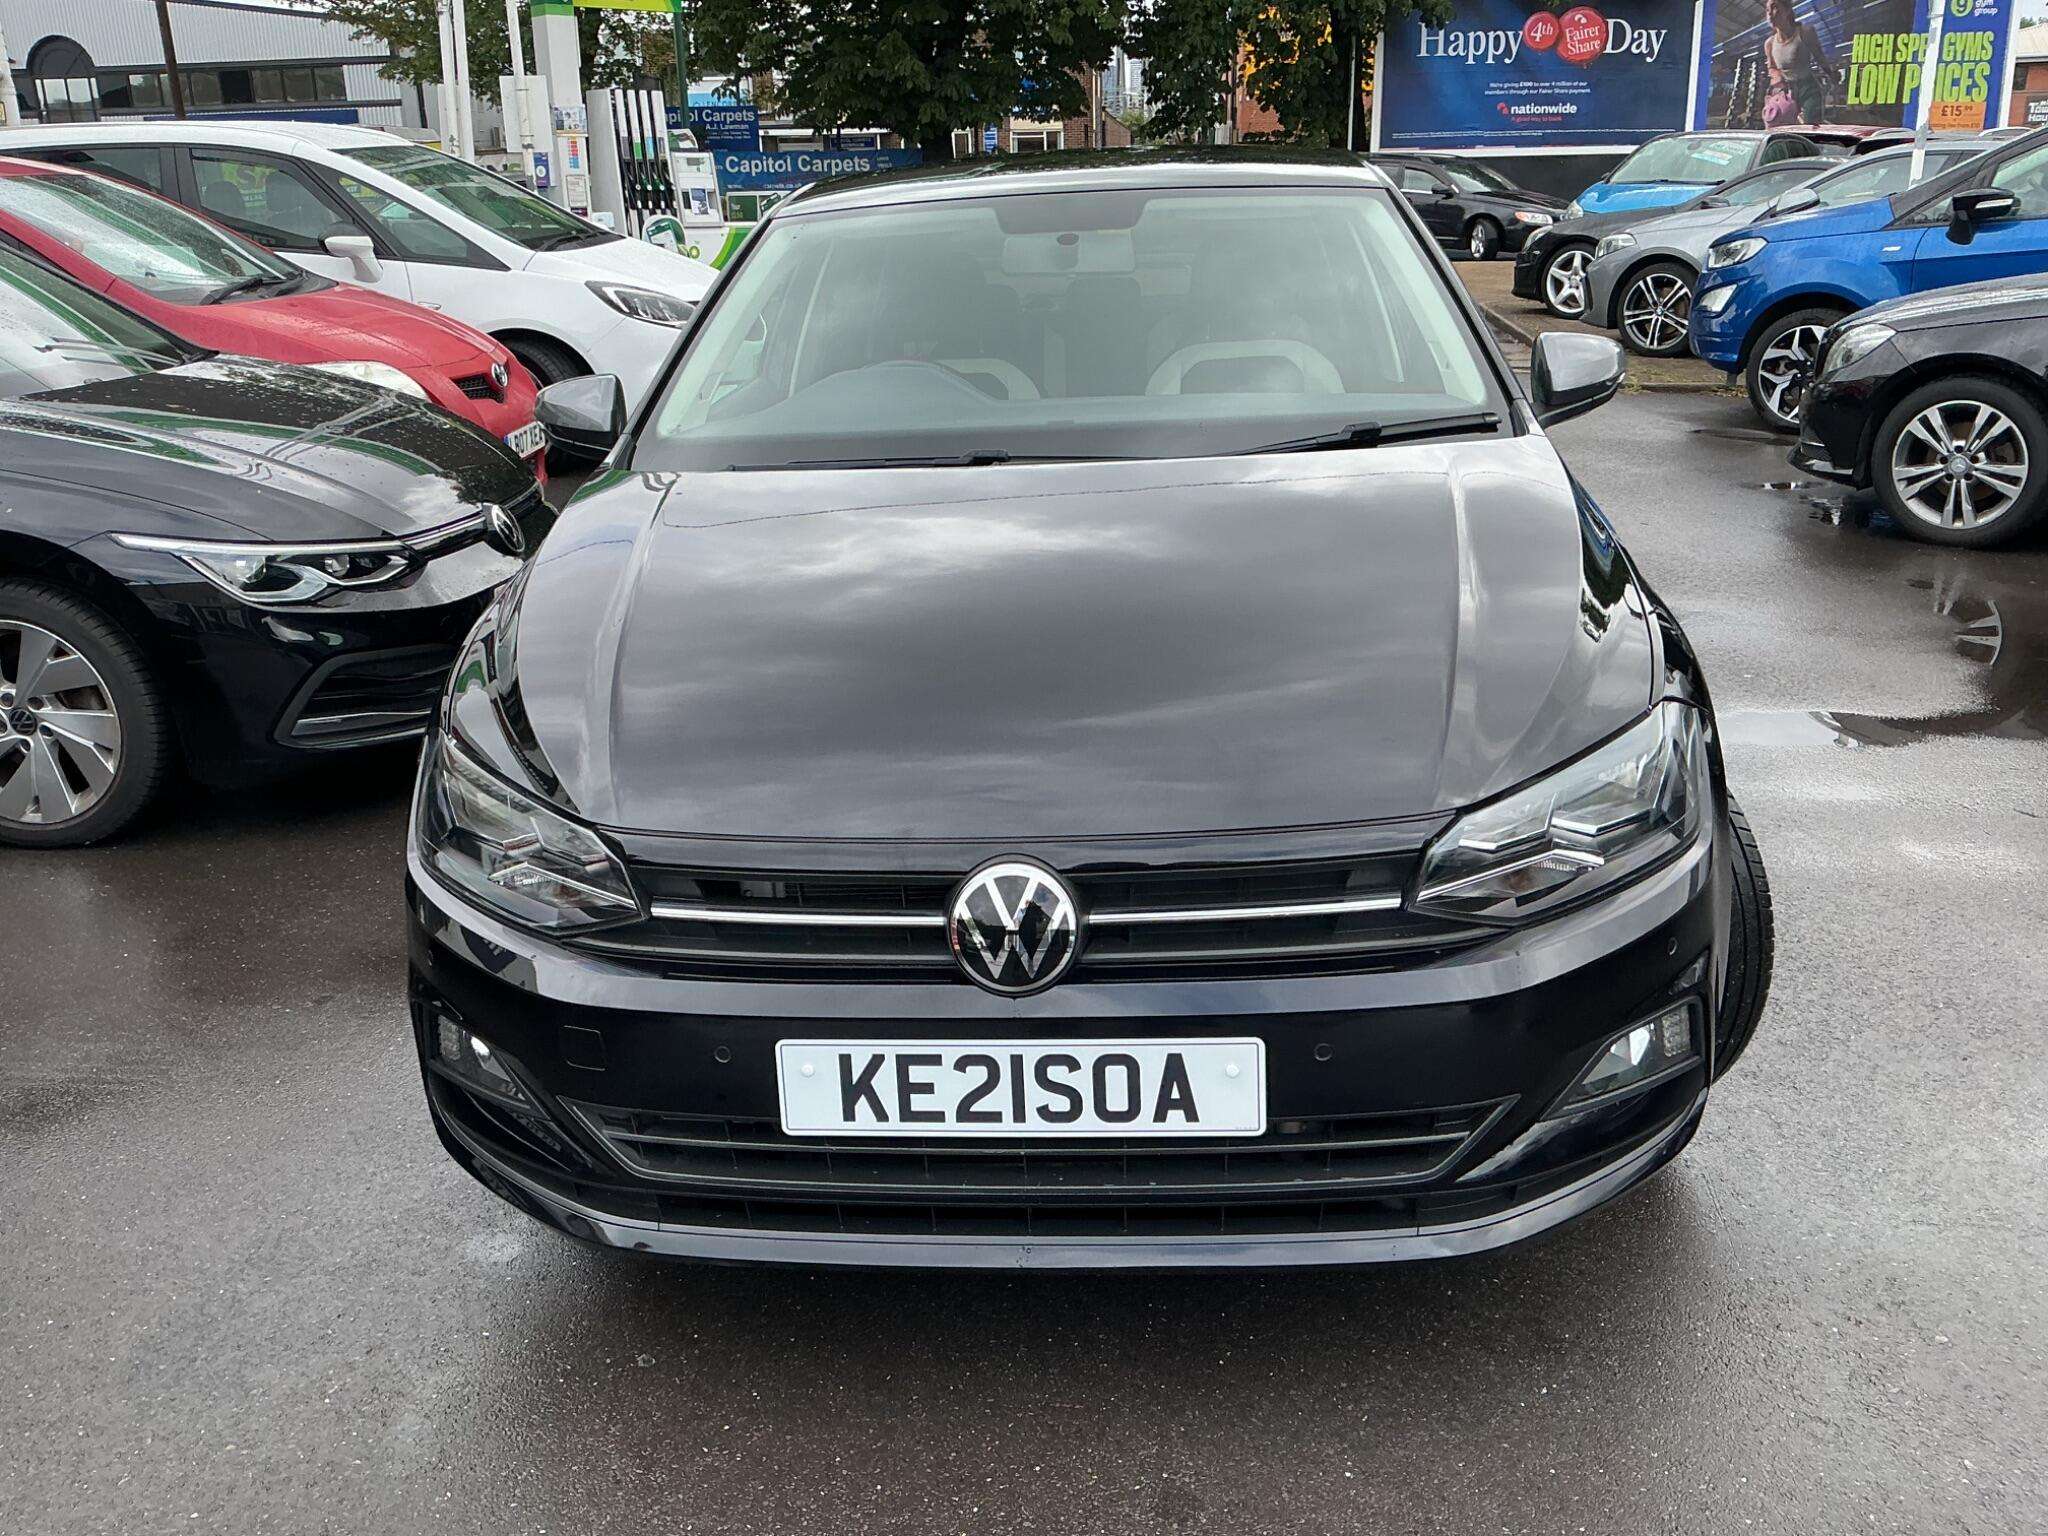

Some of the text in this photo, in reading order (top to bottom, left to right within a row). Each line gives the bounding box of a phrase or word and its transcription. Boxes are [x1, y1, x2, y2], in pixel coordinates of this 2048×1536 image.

[1974, 8, 1998, 17] group
[1530, 22, 1554, 42] 4th
[1565, 25, 1600, 42] Fairer
[1602, 18, 1667, 63] Day
[1416, 21, 1523, 65] Happy
[1567, 39, 1601, 55] Share
[1851, 31, 1994, 63] HIGH SPE GYMS
[1847, 62, 1990, 105] LOW PICES
[702, 109, 755, 124] Carpets
[1510, 102, 1577, 114] nationwide
[726, 155, 870, 176] Capitol Carpets
